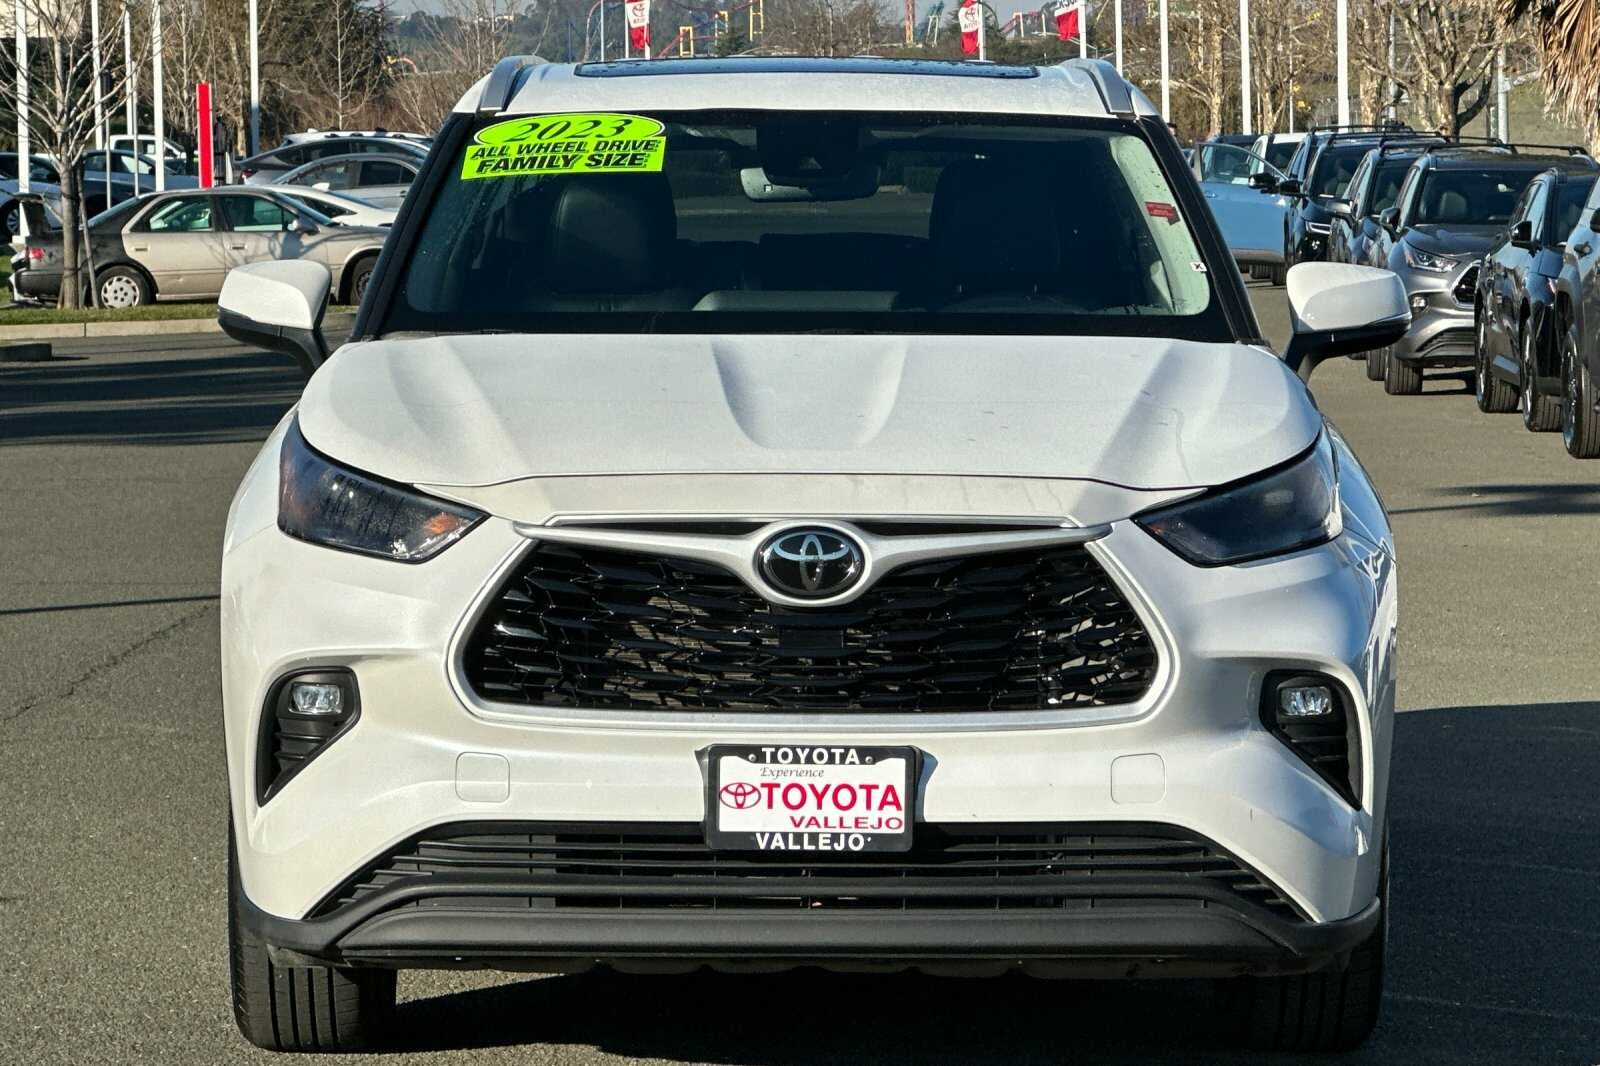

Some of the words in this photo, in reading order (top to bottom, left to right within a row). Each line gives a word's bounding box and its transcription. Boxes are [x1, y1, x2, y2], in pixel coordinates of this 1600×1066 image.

[503, 119, 632, 142] 2023
[470, 145, 511, 160] ALL
[517, 141, 587, 155] WHEEL
[593, 139, 659, 152] DRIVE
[476, 154, 581, 174] FAMILY
[585, 152, 647, 168] SIZE
[761, 747, 860, 764] TOYOTA
[760, 767, 824, 779] Experience
[760, 782, 903, 811] TOYOTA
[790, 816, 903, 830] VALLEJO
[755, 833, 865, 851] VALLEJO
